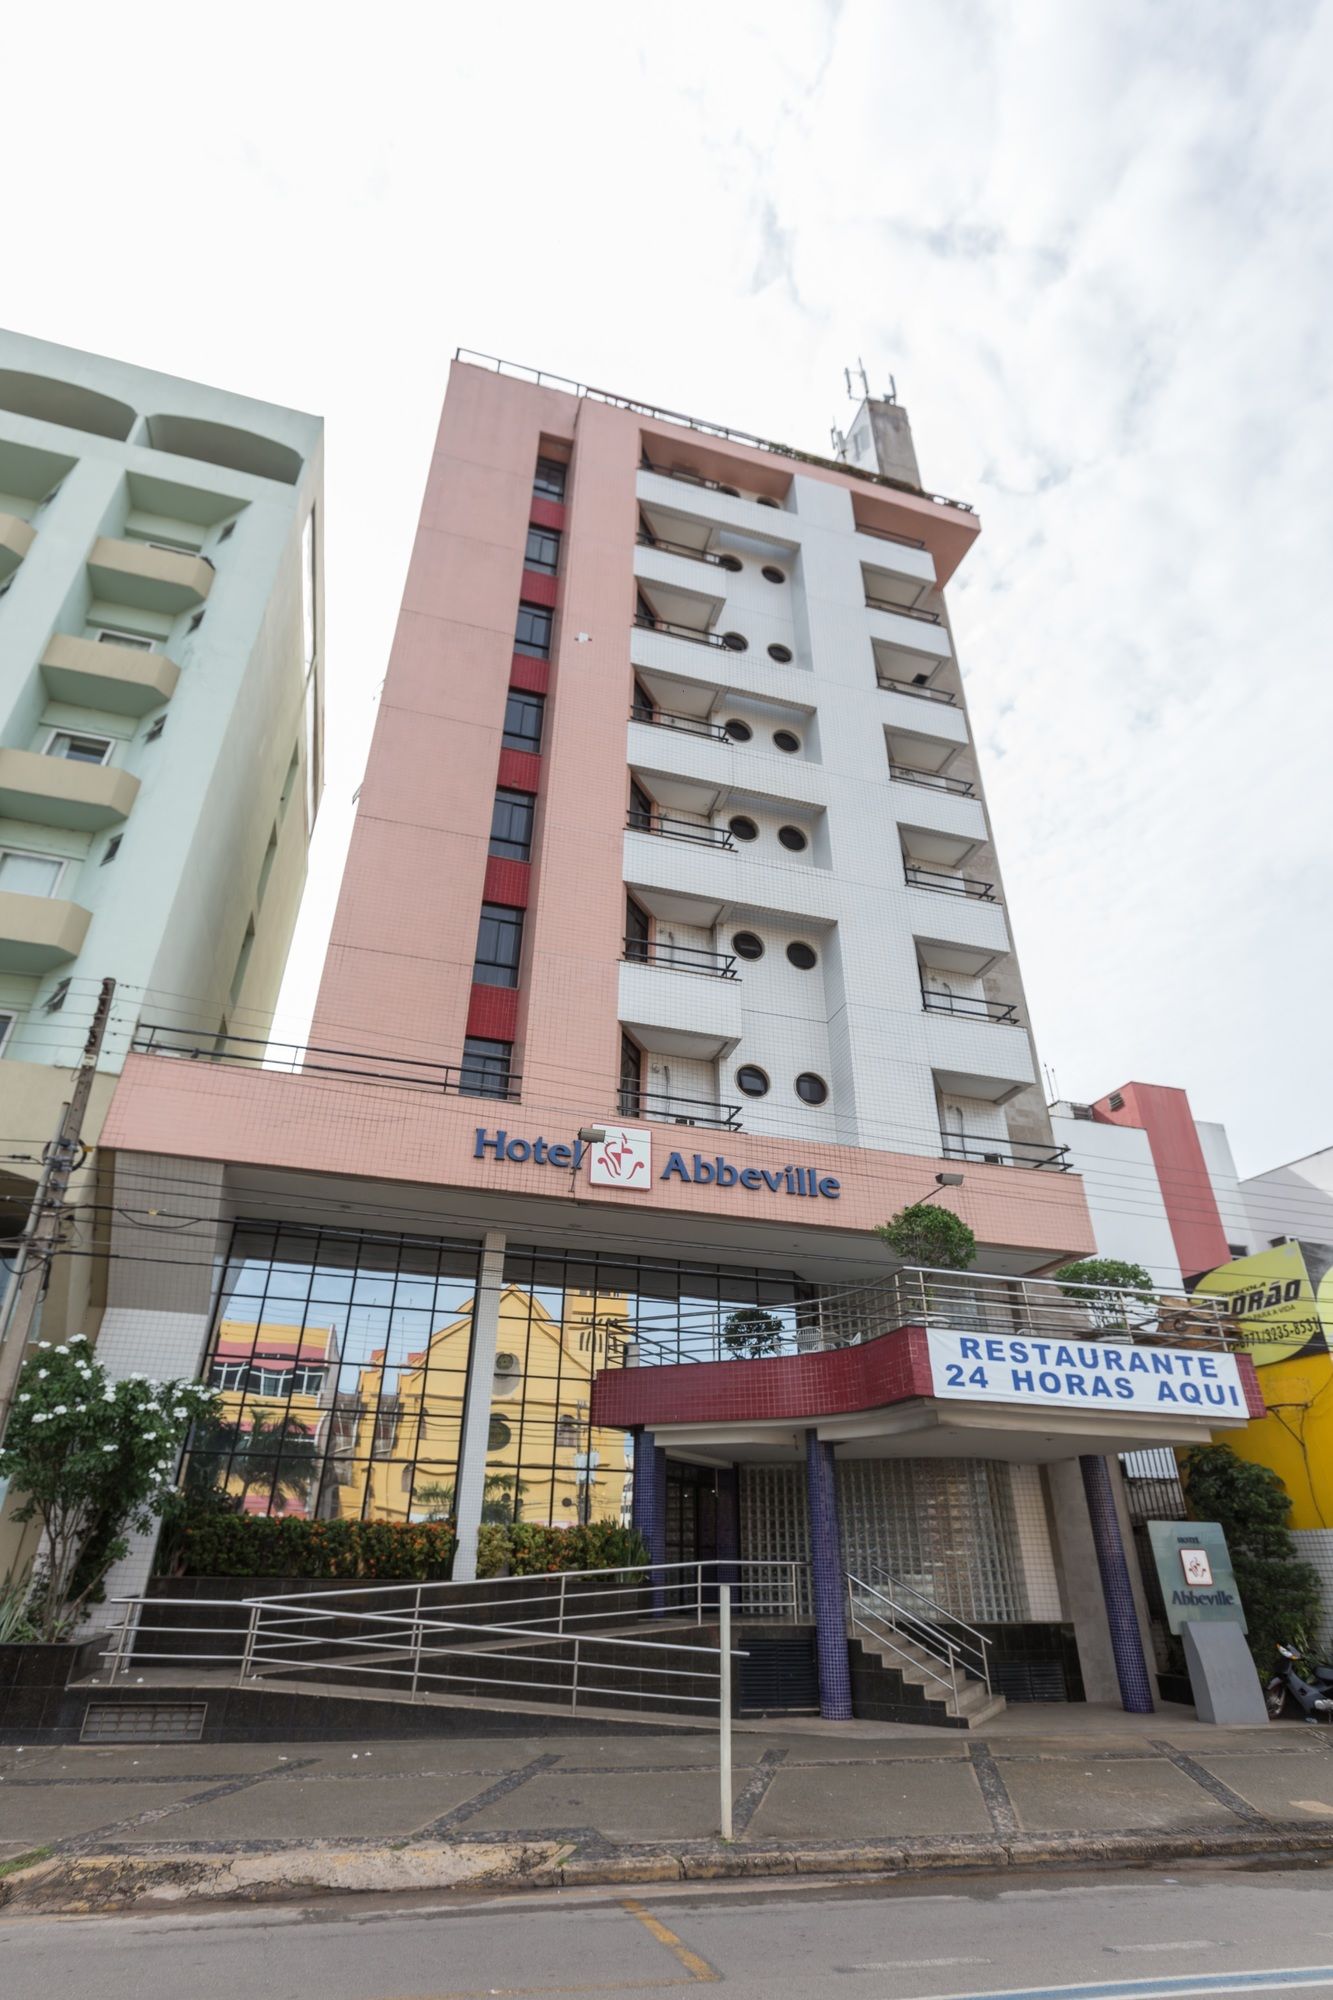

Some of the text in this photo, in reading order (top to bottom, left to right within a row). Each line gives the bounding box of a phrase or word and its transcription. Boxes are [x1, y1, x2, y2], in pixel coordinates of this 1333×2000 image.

[473, 1128, 841, 1199] Hotel Abbeville
[959, 1337, 1218, 1378] RESTAURANTE
[945, 1363, 1240, 1406] 24 HORAS AQUI
[1172, 1590, 1235, 1606] Abbeville
